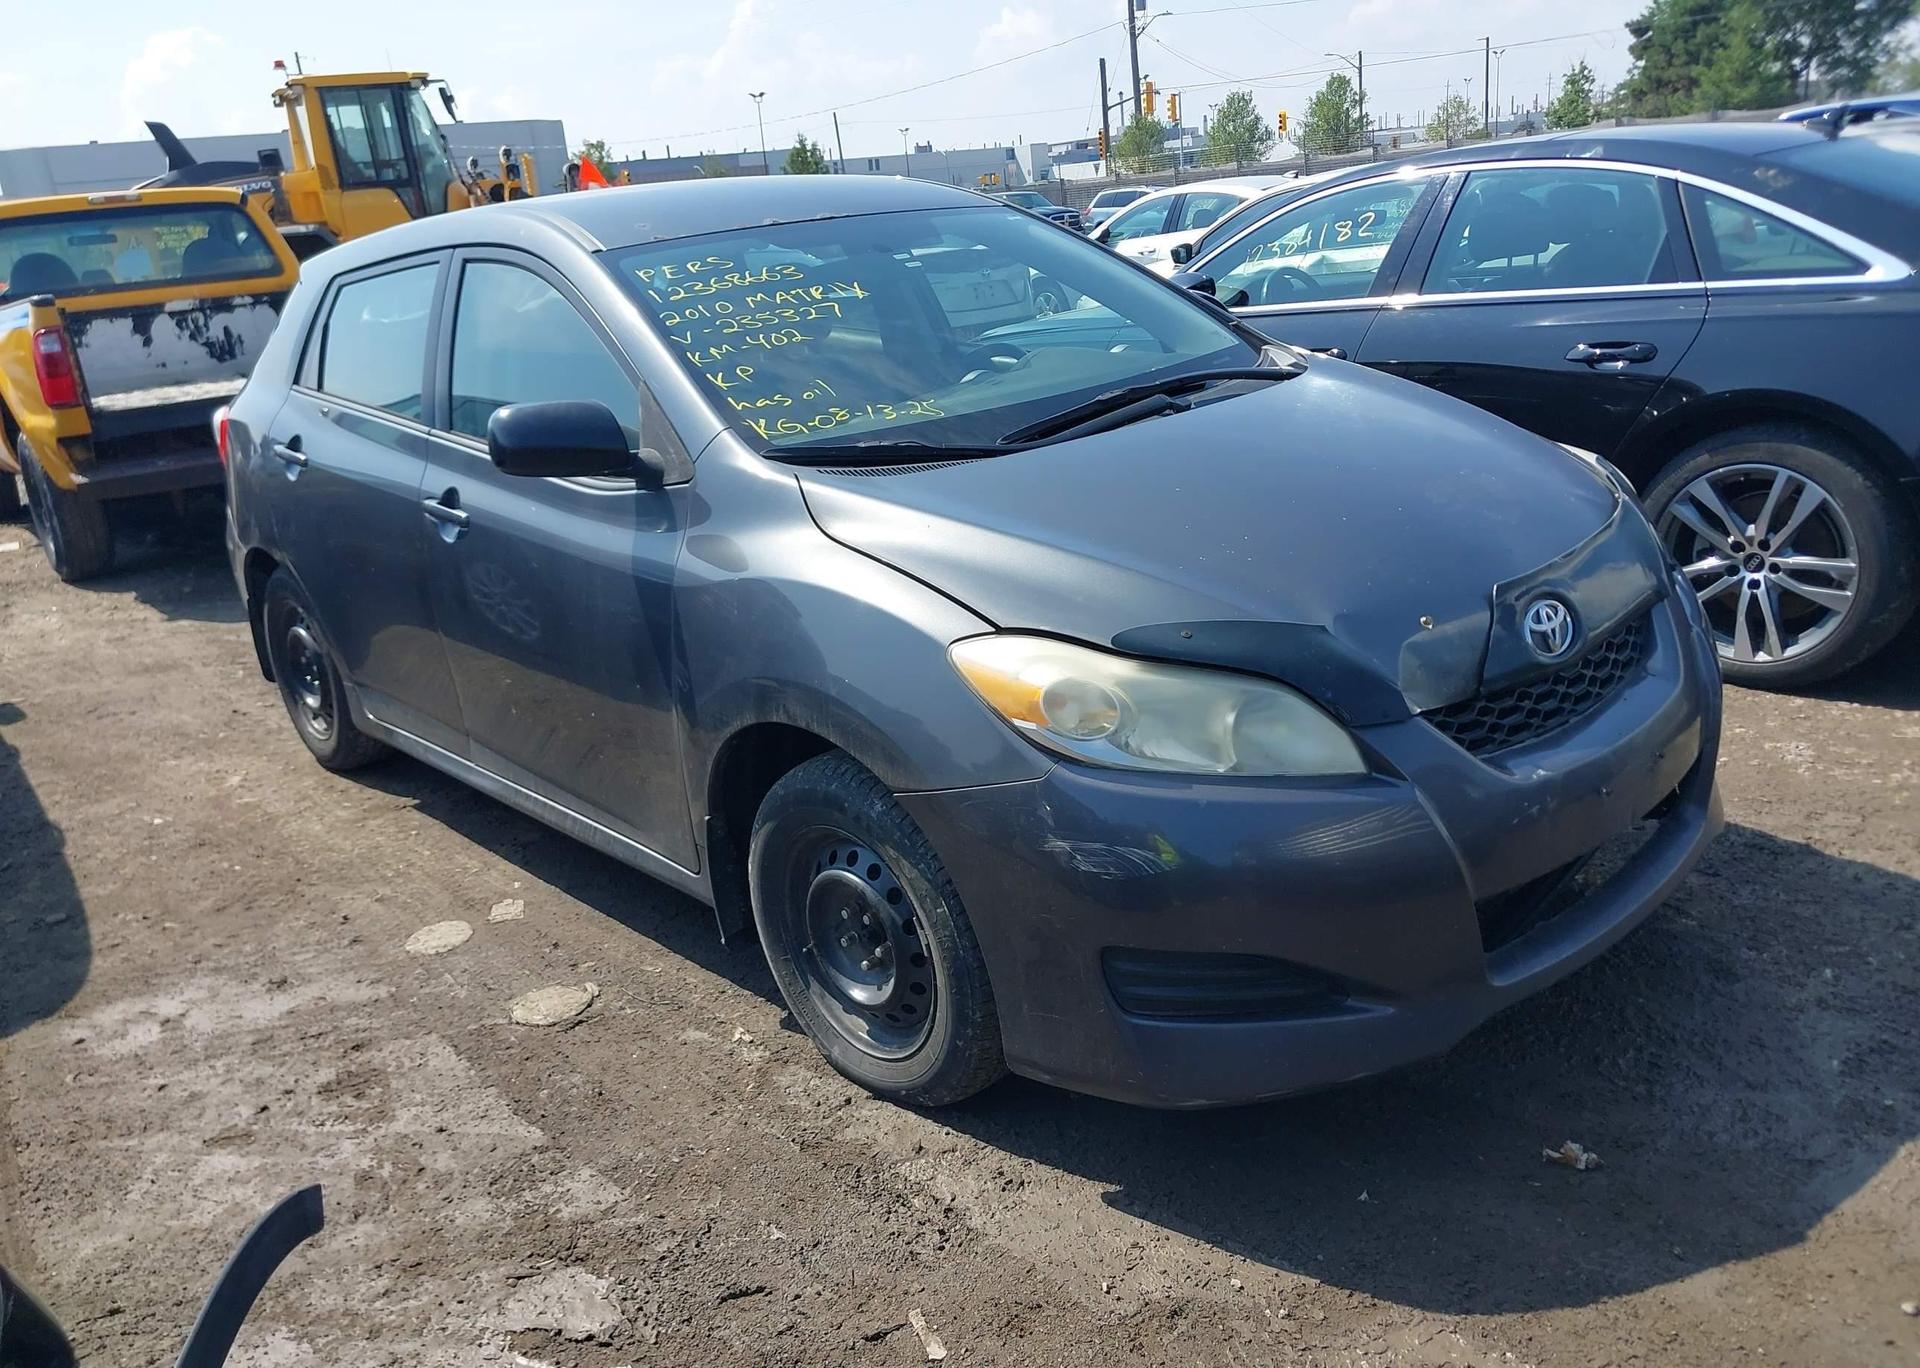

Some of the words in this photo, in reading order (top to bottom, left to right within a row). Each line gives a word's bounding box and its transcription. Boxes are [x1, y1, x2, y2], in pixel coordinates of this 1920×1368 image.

[635, 256, 734, 282] PERS
[648, 264, 804, 303] 12368663
[659, 302, 733, 327] 2010
[746, 281, 871, 309] MATRIX
[727, 394, 792, 411] has
[803, 379, 837, 400] oil
